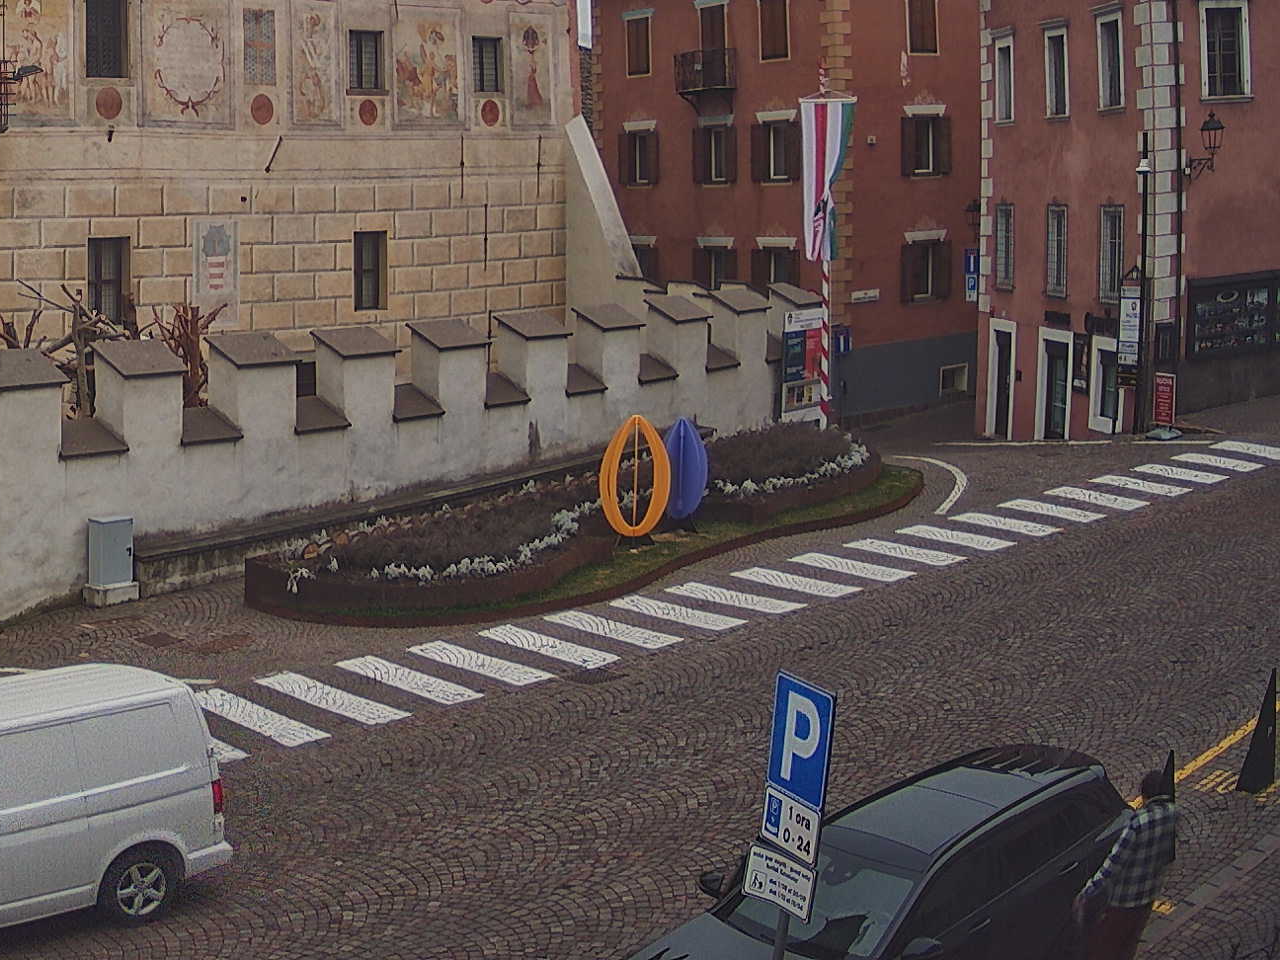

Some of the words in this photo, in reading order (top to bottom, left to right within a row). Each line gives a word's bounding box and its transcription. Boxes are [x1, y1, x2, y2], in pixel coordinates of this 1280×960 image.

[780, 690, 821, 780] P
[788, 806, 793, 820] 1
[795, 812, 811, 831] ora
